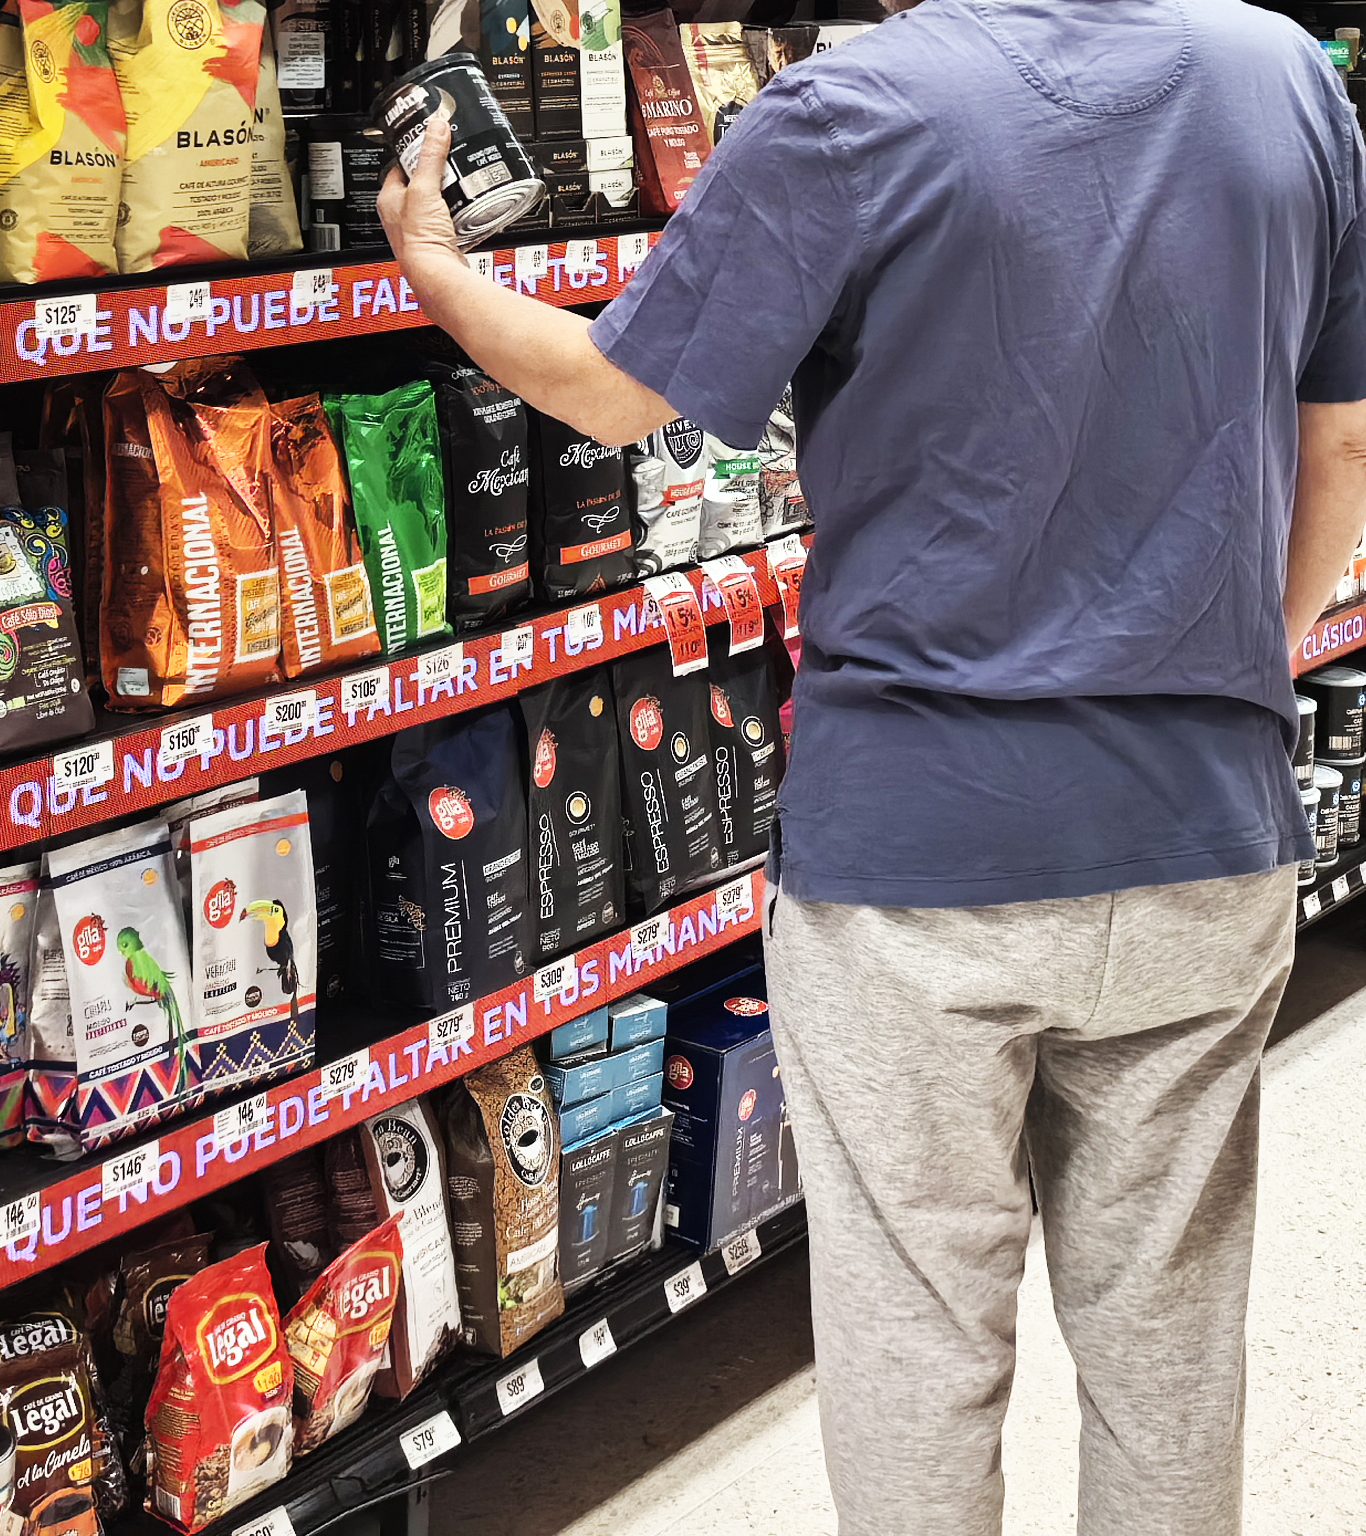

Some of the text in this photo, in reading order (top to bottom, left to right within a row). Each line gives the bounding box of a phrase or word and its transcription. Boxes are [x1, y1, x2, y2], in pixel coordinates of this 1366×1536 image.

[50, 148, 117, 168] BLASÓN
[581, 539, 624, 559] GOURMET
[184, 491, 217, 695] INTERNACIONAL
[2, 614, 23, 628] Café
[40, 606, 58, 620] Dios
[1302, 619, 1362, 660] CLÁSICO
[540, 813, 554, 920] ESPRESSO
[446, 862, 463, 974] PREMIUM
[11, 1385, 79, 1436] Legal
[44, 1439, 92, 1475] Canela
